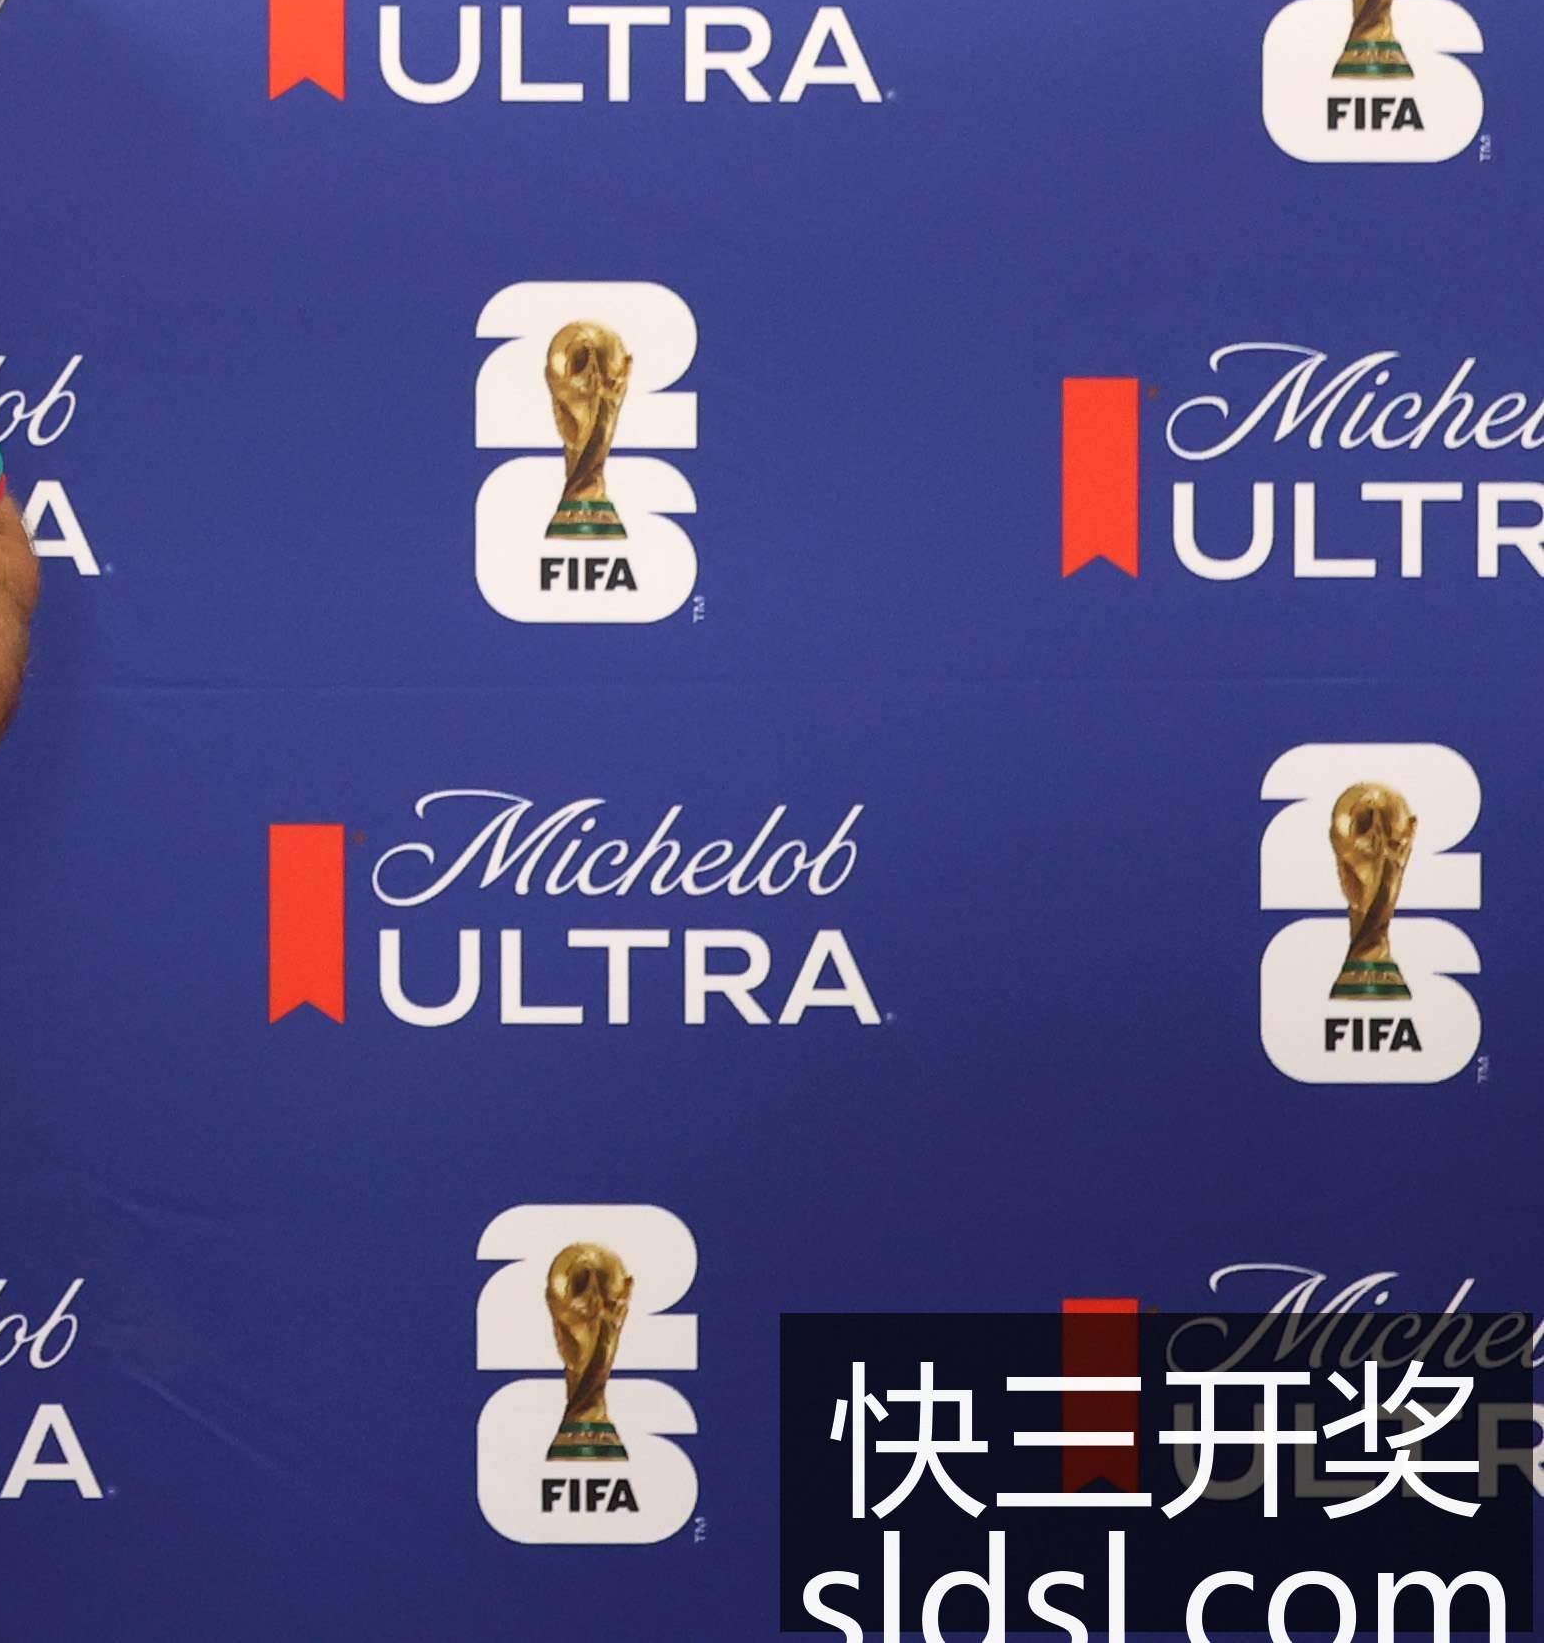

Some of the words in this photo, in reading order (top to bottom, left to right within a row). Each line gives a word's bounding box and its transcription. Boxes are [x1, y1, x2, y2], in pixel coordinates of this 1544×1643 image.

[380, 5, 881, 104] ULTRA
[1328, 98, 1423, 130] FIFA
[1166, 343, 1544, 460] Miche
[541, 558, 637, 590] FIFA
[373, 790, 863, 906] Michelob
[380, 929, 881, 1027] ULTRA
[1325, 1018, 1421, 1051] FIFA
[1167, 1263, 1544, 1381] Miche
[542, 1479, 638, 1512] FIFA
